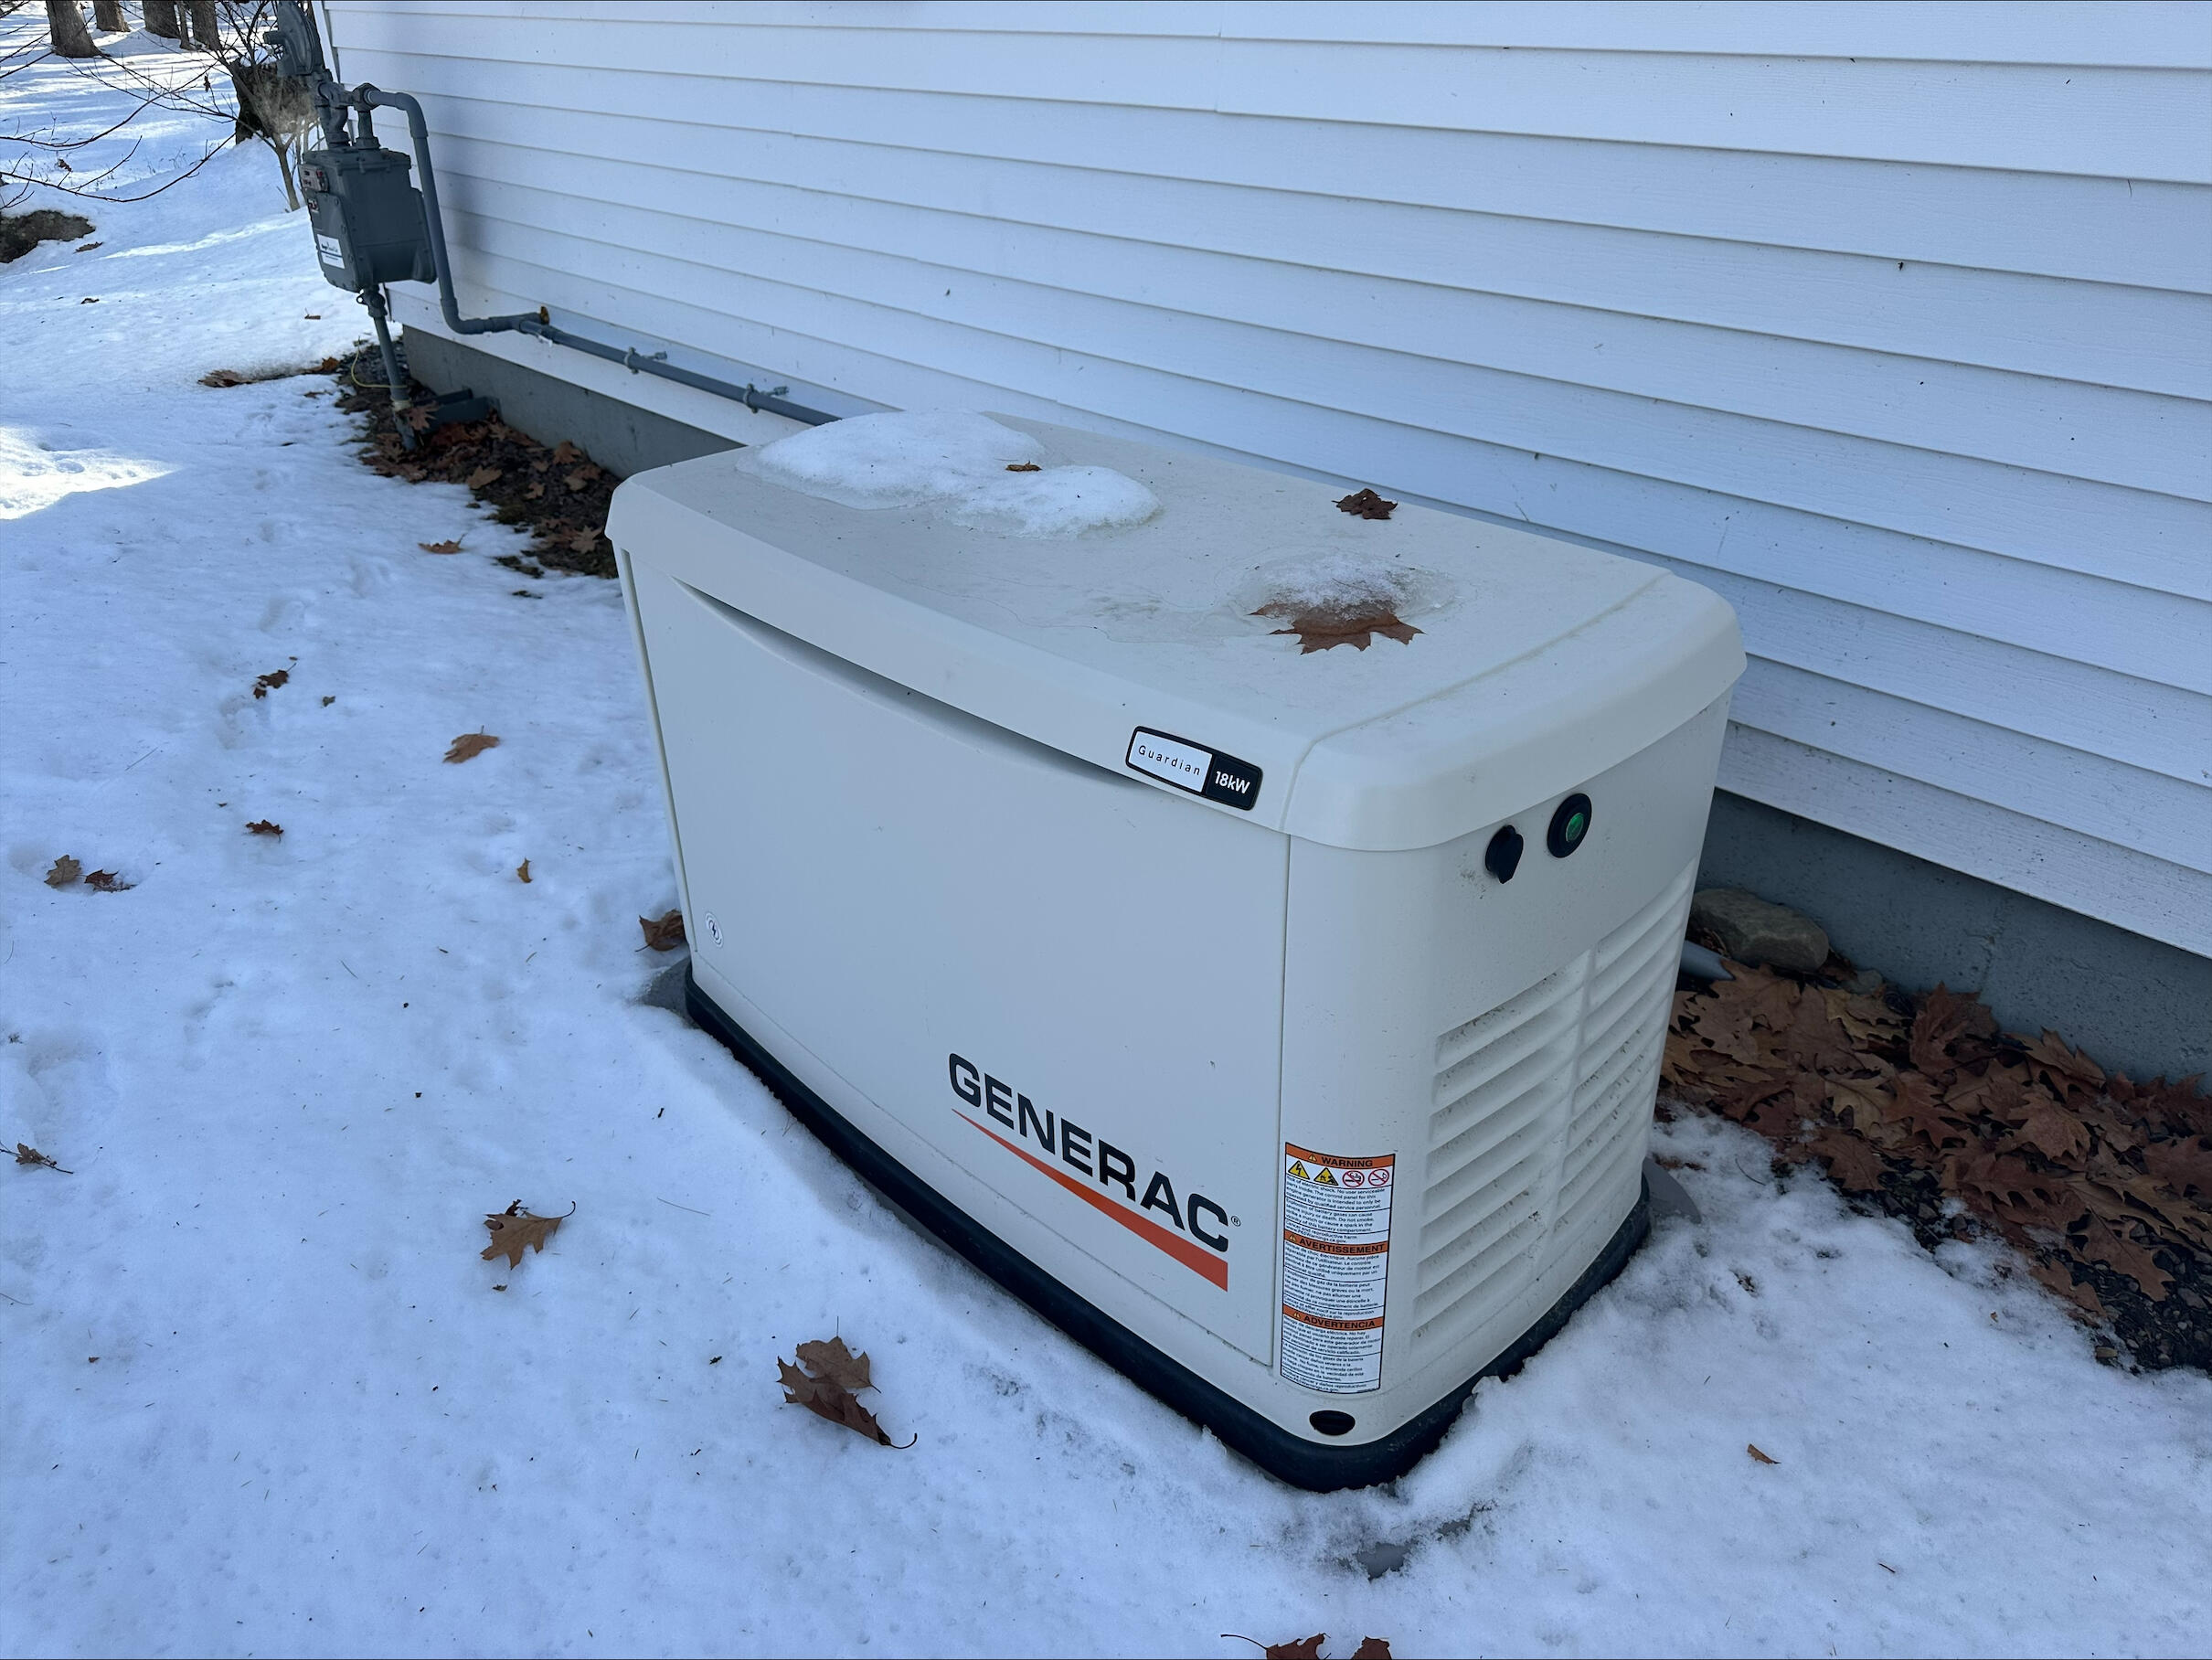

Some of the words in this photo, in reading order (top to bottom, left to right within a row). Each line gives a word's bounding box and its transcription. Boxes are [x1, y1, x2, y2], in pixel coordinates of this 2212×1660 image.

[1138, 745, 1201, 776] Guardian
[1215, 771, 1250, 794] 18kW
[949, 1053, 1228, 1252] GENERAC
[1321, 1156, 1373, 1167] WARNING
[1300, 1239, 1384, 1253] AVERTISSEMENT
[1303, 1315, 1375, 1329] ADVERTENCIA
